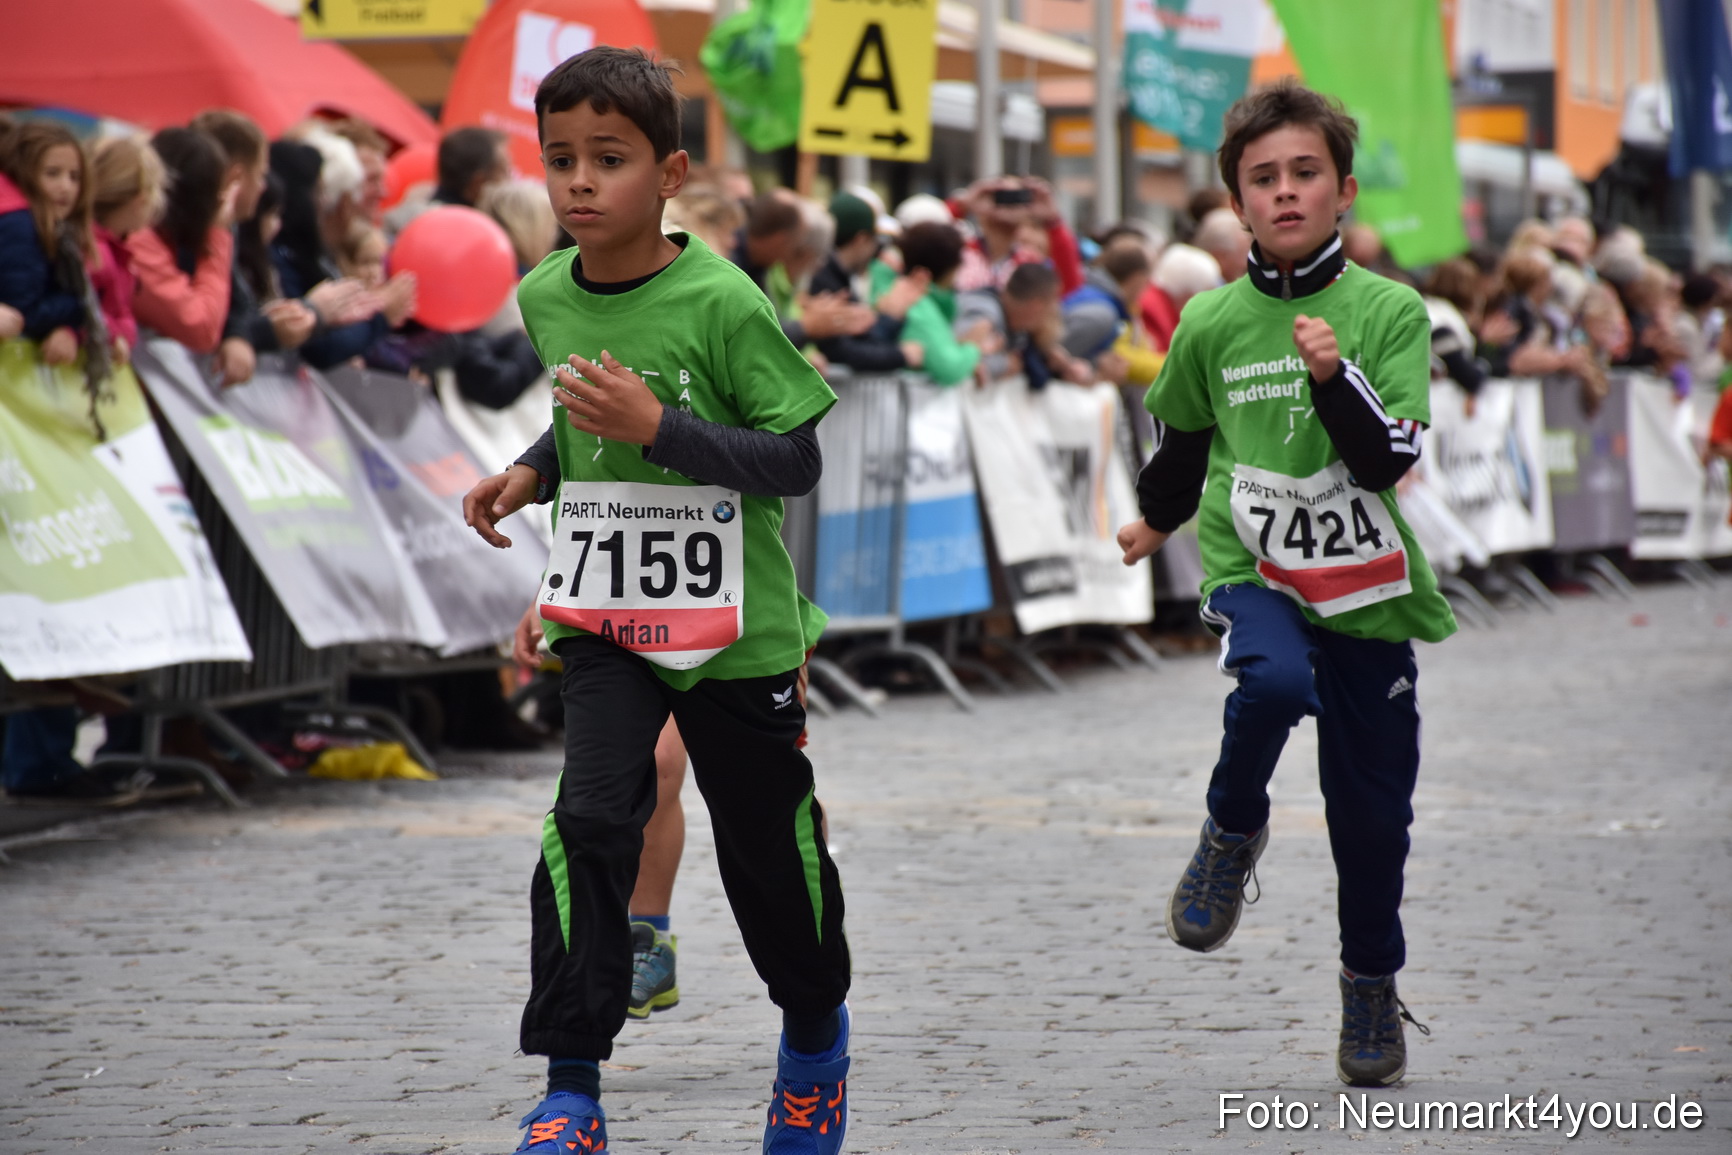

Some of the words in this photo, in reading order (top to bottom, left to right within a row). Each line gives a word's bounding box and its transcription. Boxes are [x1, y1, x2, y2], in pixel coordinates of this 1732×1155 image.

[834, 21, 902, 113] A
[1221, 354, 1309, 384] Neumarkt
[1227, 378, 1304, 407] Stadtlauf
[1237, 480, 1285, 499] PARTL
[1286, 481, 1346, 507] Neumarkt
[561, 502, 605, 519] PARTL
[607, 502, 704, 521] Neumarkt
[1249, 496, 1384, 560] 7424
[568, 530, 723, 599] 7159
[600, 618, 670, 646] Arian
